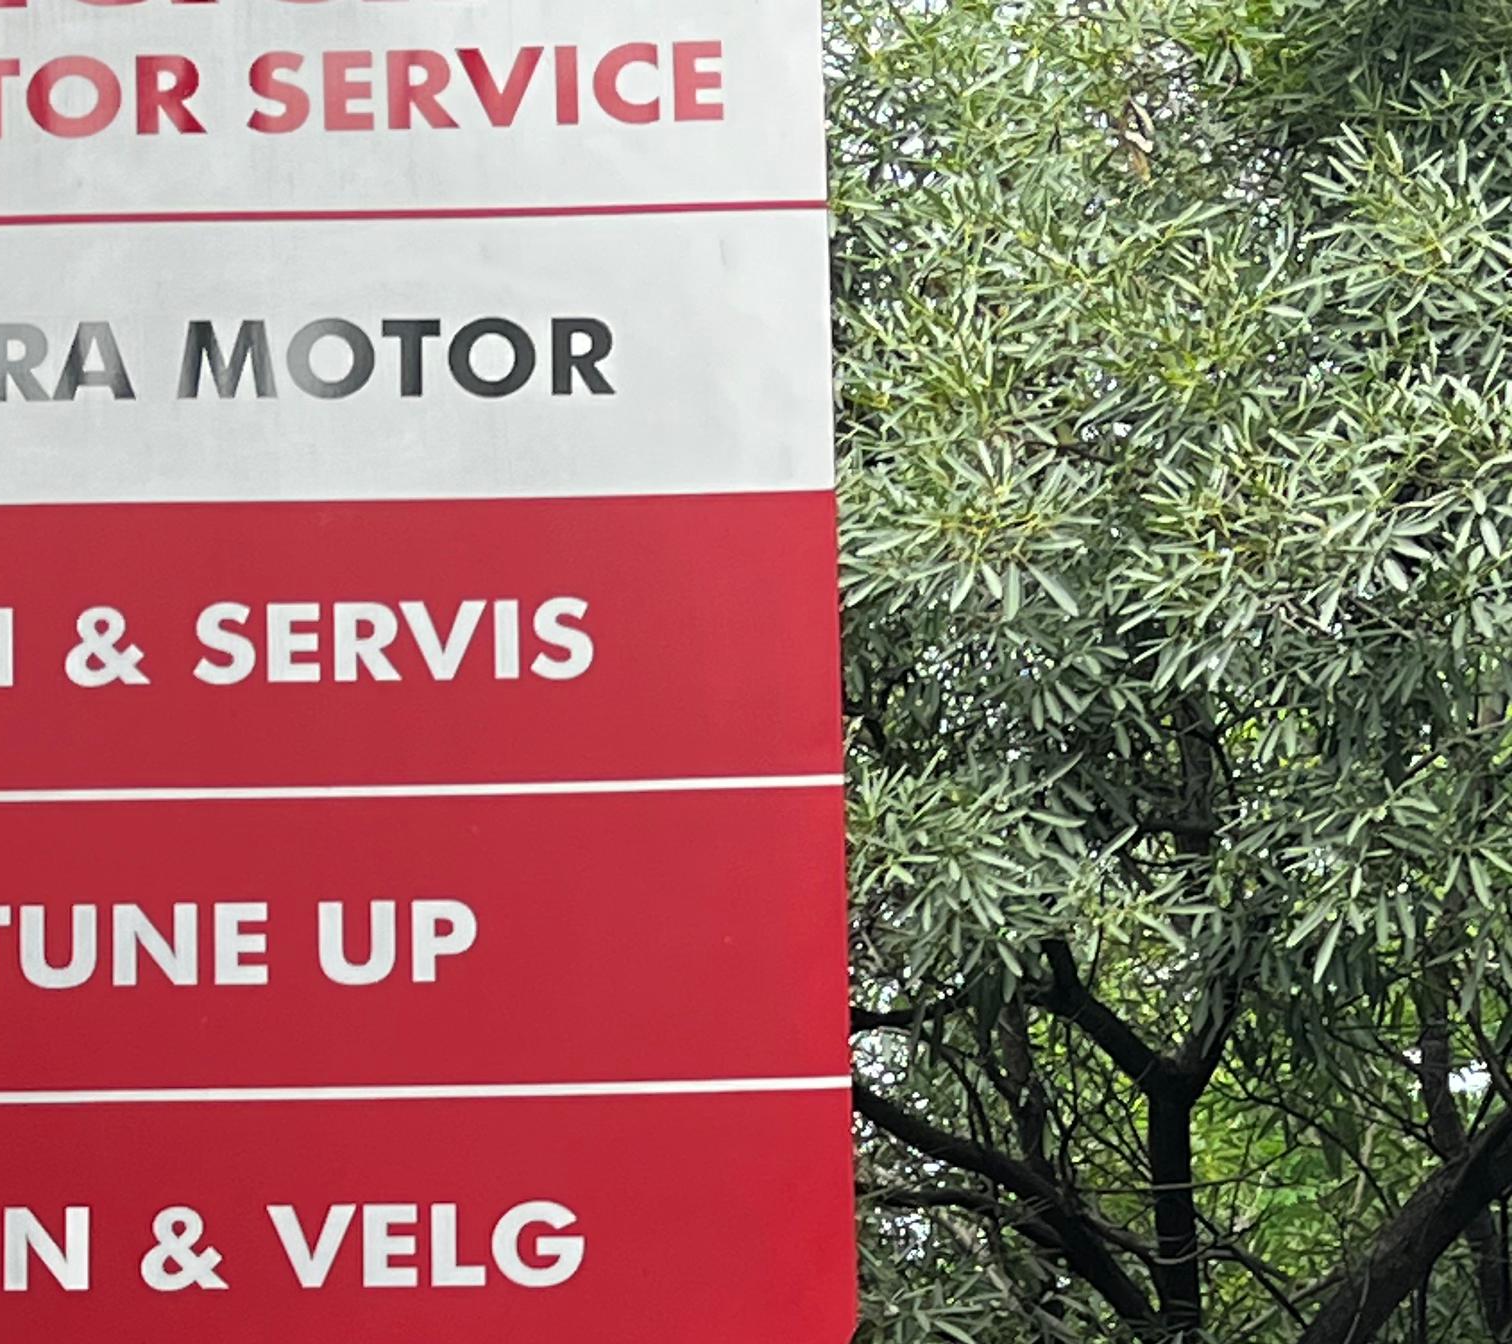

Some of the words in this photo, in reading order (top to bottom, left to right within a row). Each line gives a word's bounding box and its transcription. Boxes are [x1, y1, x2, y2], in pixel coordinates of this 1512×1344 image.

[246, 39, 726, 135] SERVICE
[175, 316, 618, 401] MOTOR
[63, 605, 152, 689] &
[192, 595, 595, 686] SERVIS
[317, 898, 478, 987] UP
[139, 1205, 230, 1293] &
[265, 1199, 586, 1289] VELG
